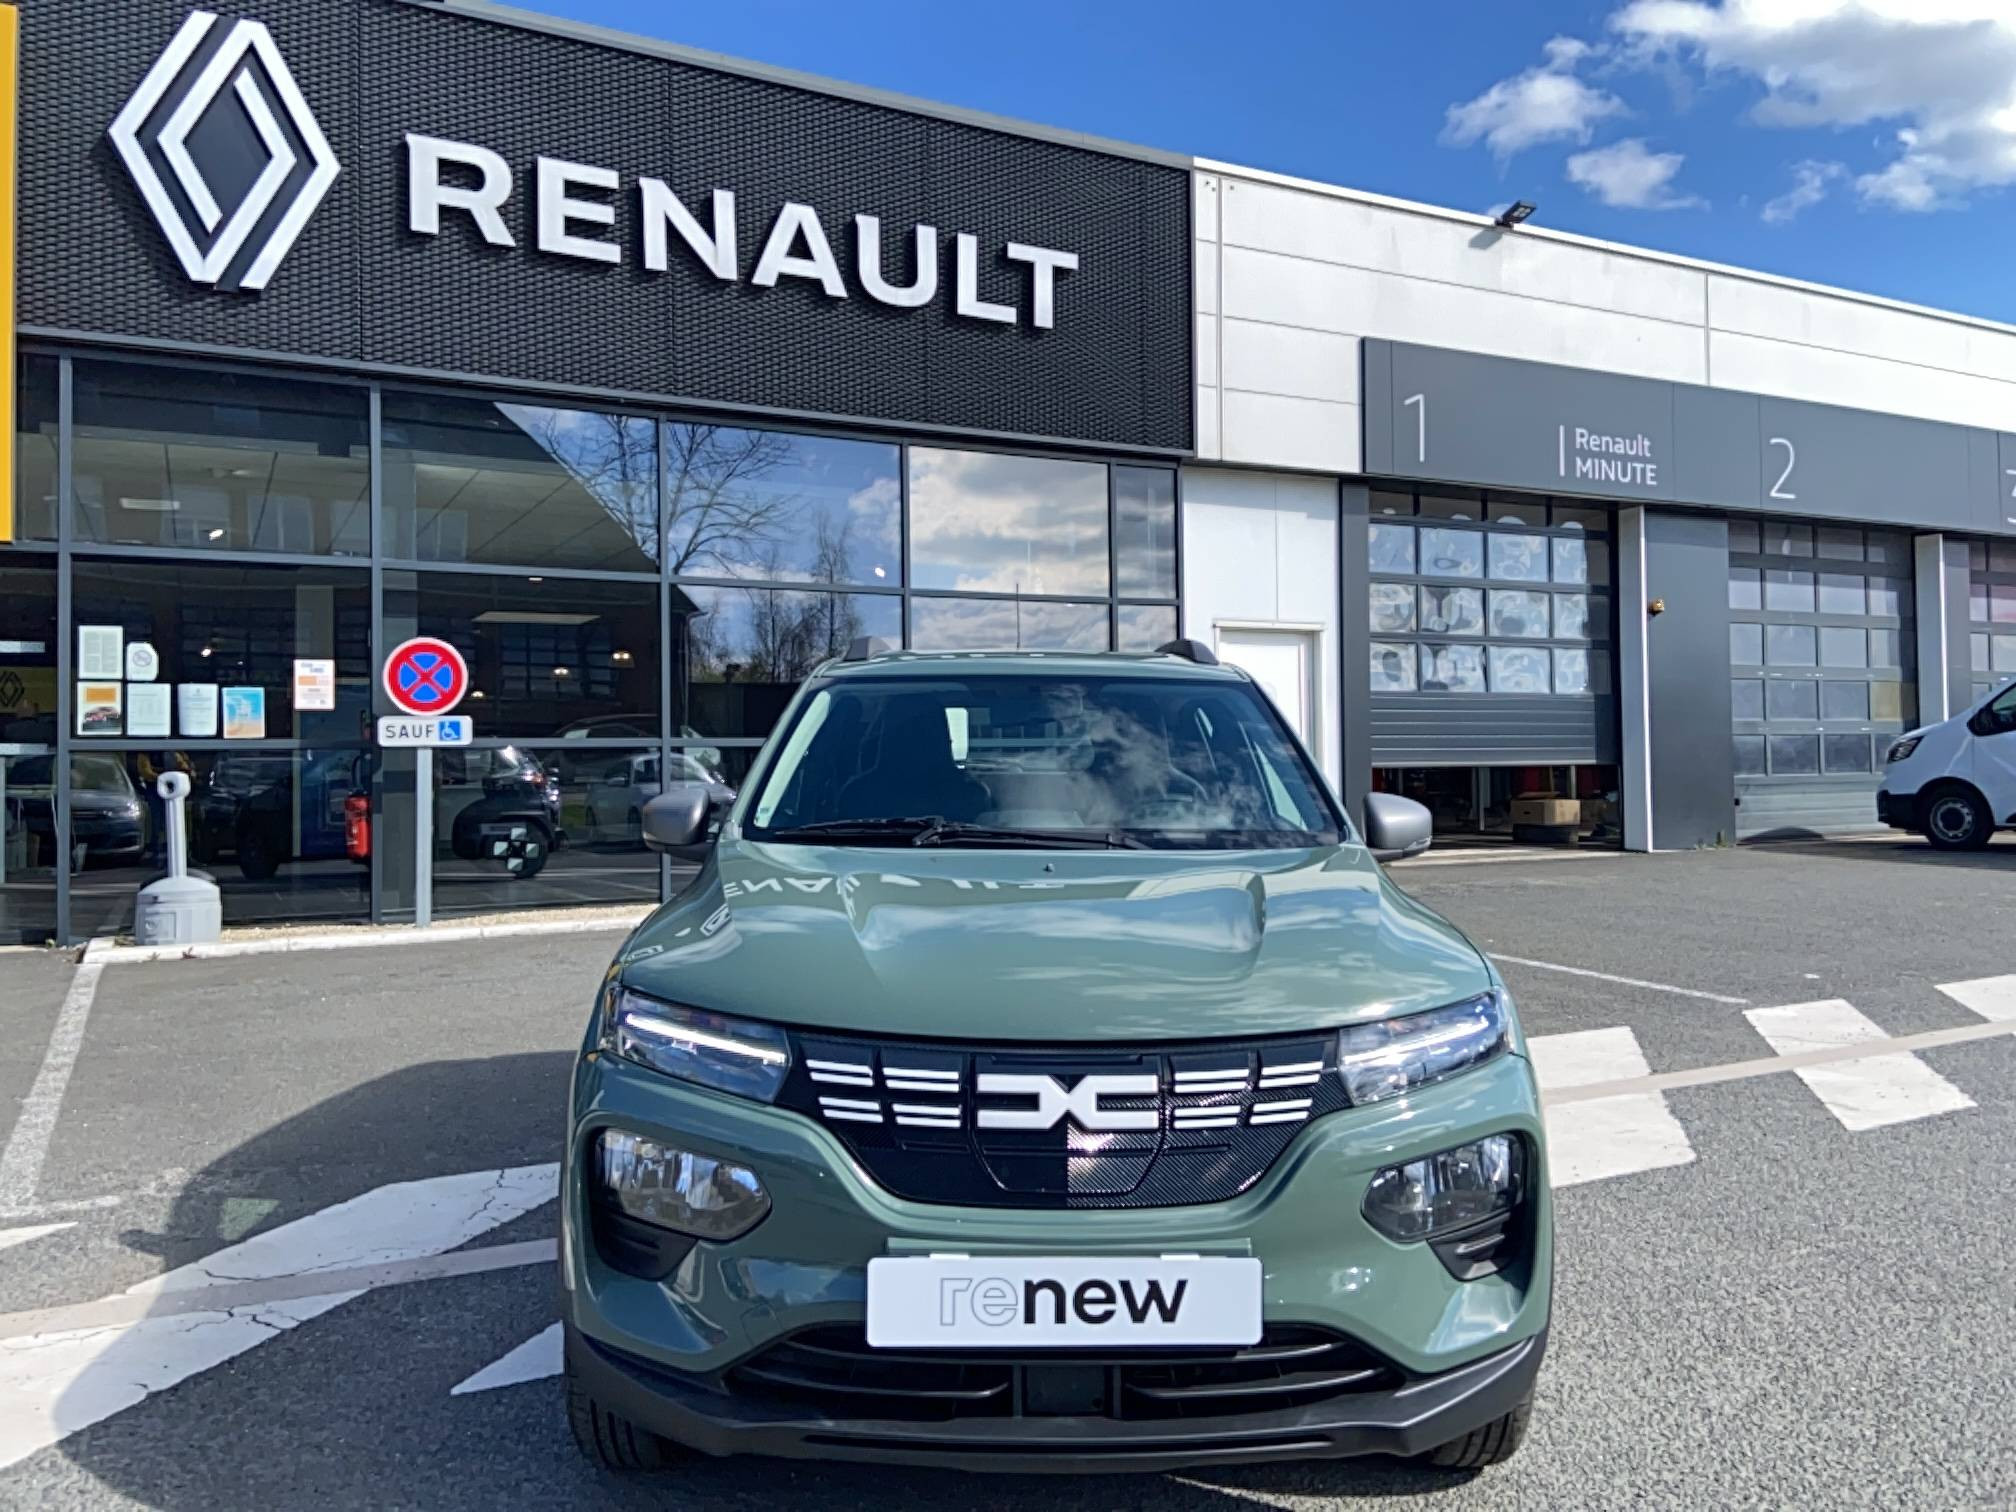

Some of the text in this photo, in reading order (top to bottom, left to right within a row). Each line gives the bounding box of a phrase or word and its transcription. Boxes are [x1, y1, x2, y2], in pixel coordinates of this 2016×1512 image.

[404, 130, 1080, 331] RENAULT
[1403, 393, 1426, 463] 1
[1574, 427, 1652, 458] Renault
[1574, 458, 1659, 487] MINUTE
[1768, 437, 1798, 500] 2
[385, 723, 435, 740] SAUF
[939, 1277, 1188, 1326] renew
